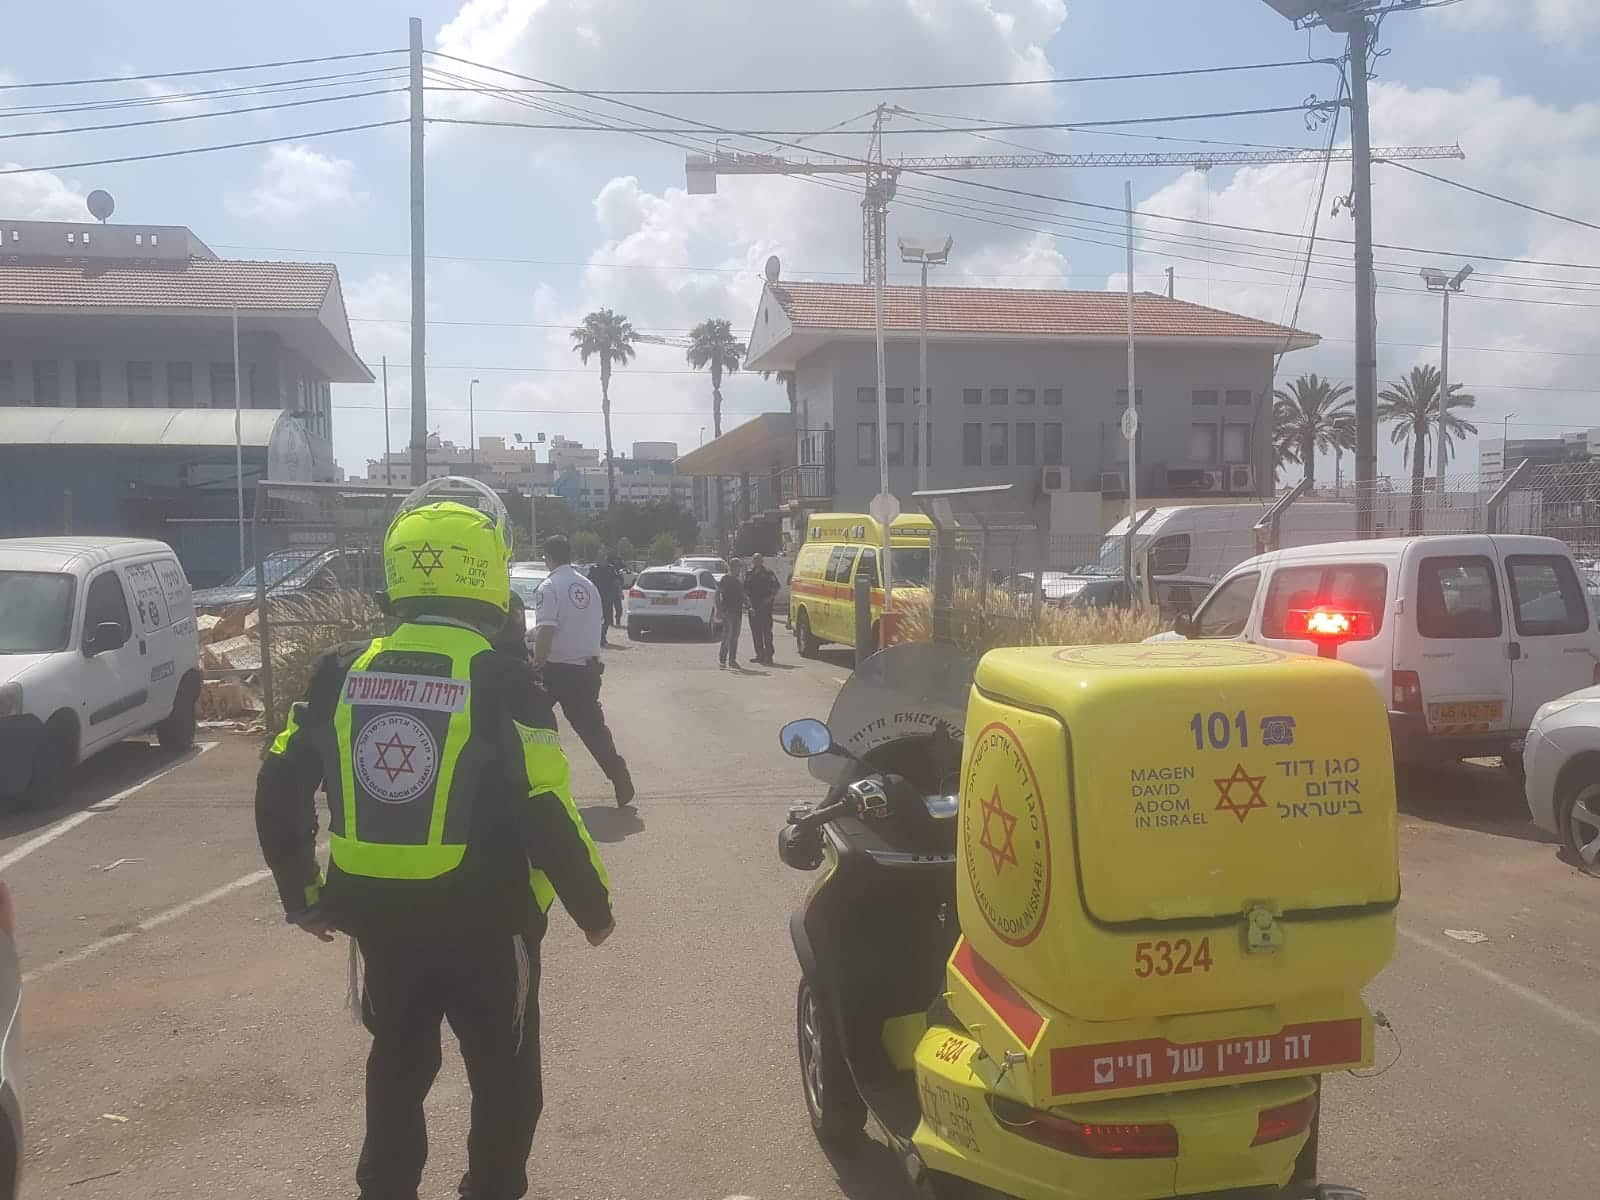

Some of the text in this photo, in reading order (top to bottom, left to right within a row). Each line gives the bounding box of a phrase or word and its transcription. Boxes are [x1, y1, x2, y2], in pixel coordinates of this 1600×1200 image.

[420, 681, 465, 707] יחידת
[1190, 710, 1248, 750] 101
[1130, 766, 1195, 782] MAGEN
[1275, 757, 1361, 777] מגן דוד
[1131, 782, 1180, 798] DAVID
[1306, 779, 1361, 797] אדום
[1134, 799, 1191, 814] ADOM
[1277, 799, 1363, 819] בישראל
[1135, 812, 1208, 829] IN ISRAEL
[997, 915, 1025, 934] ADOM
[1135, 936, 1213, 978] 5324
[936, 1037, 969, 1064] 5324
[1217, 1038, 1271, 1073] עניין
[1284, 1034, 1312, 1061] זה
[1166, 1047, 1204, 1075] של
